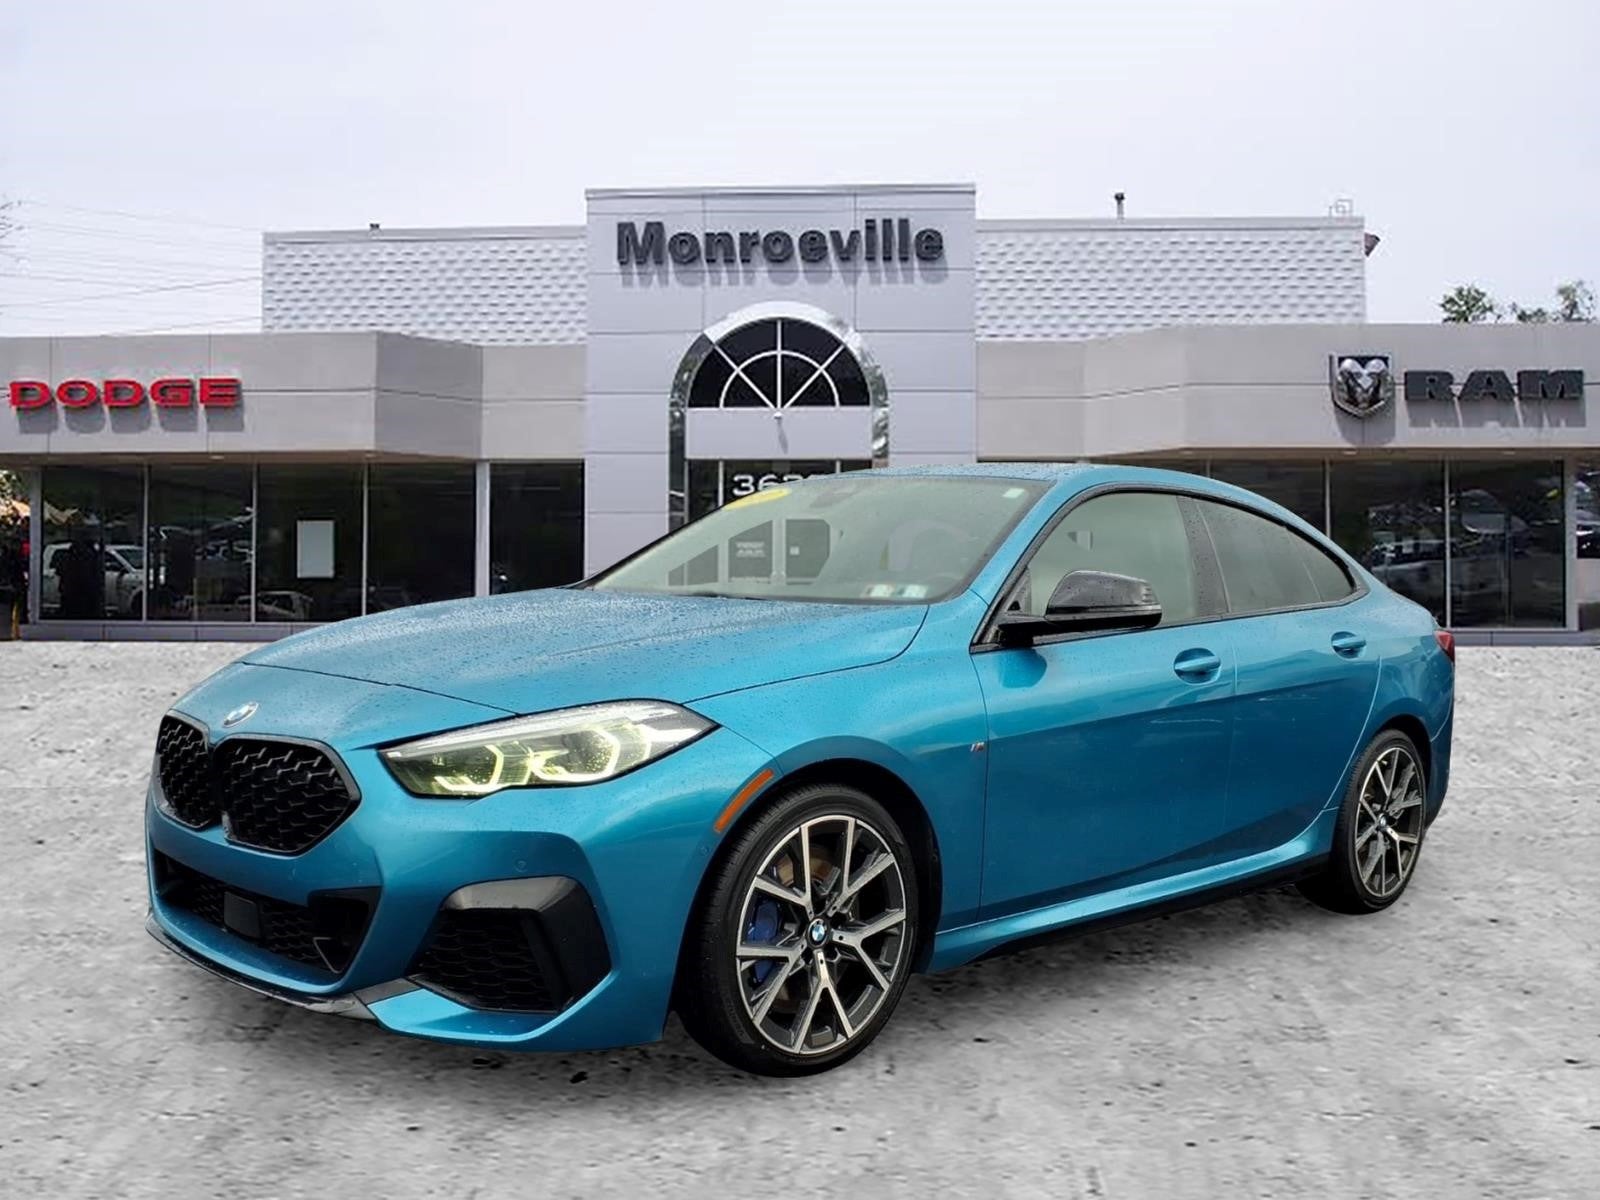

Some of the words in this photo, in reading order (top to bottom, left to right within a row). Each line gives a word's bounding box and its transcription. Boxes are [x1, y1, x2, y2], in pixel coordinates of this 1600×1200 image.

[616, 218, 944, 266] Monroeville
[9, 378, 242, 408] DODGE
[1404, 369, 1585, 401] RAM
